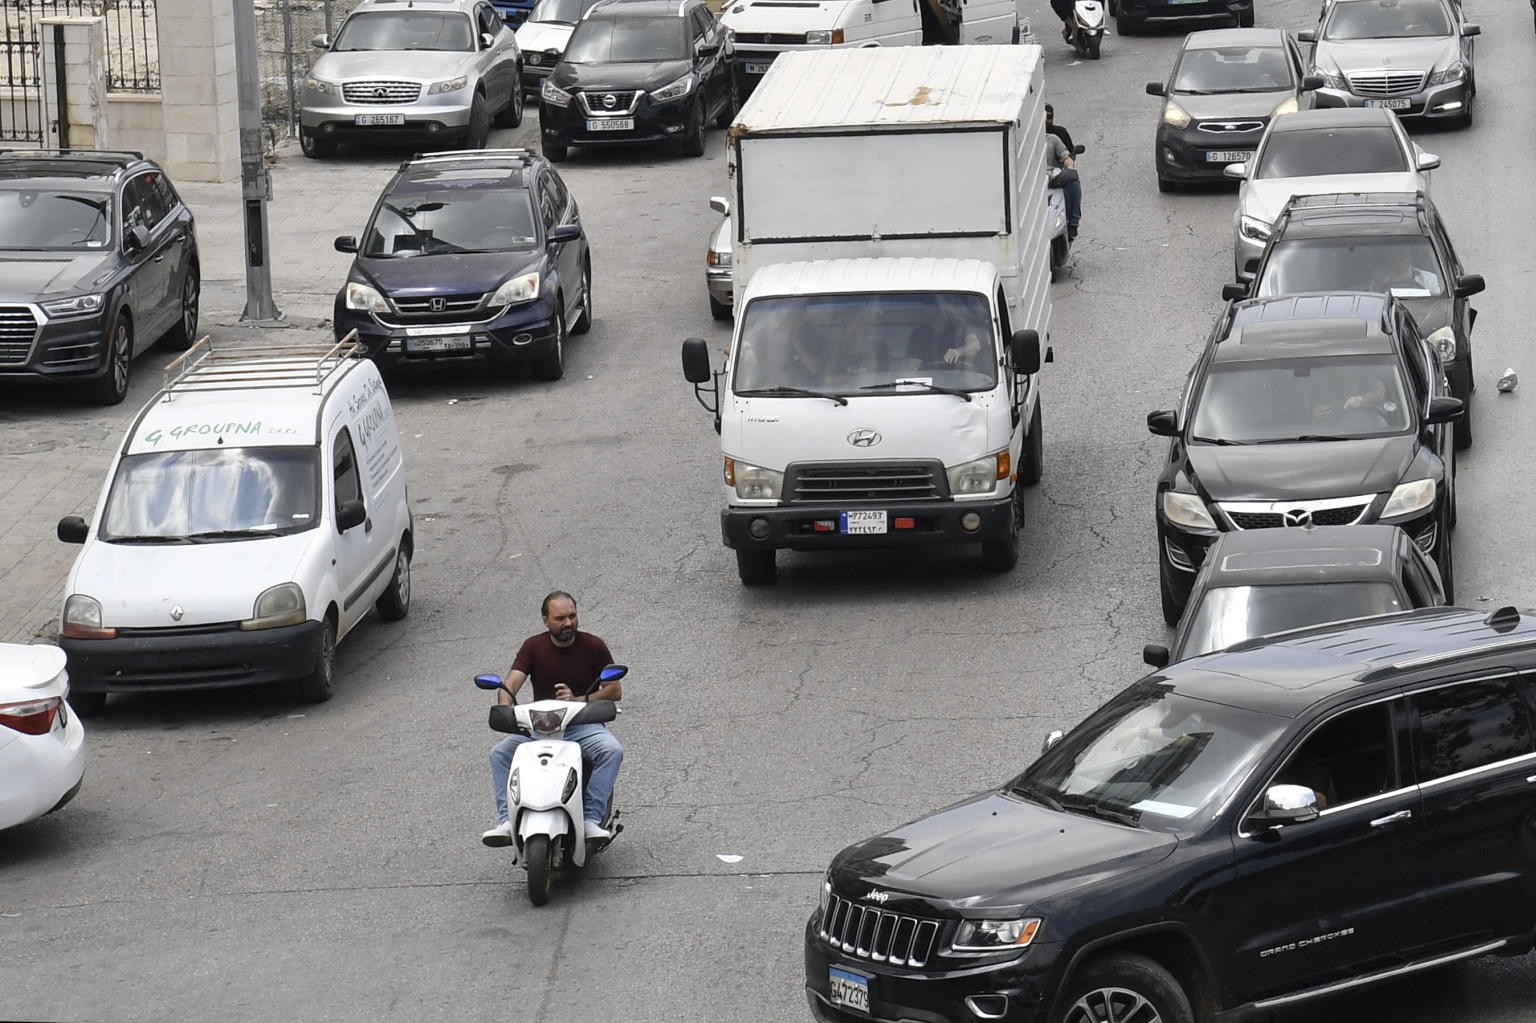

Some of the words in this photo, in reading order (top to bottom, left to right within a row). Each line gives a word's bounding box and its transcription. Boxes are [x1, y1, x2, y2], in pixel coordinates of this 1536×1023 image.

[1212, 152, 1218, 161] G
[169, 421, 262, 440] GROUPNA
[866, 888, 889, 904] Jeep
[1260, 942, 1296, 957] GRAND
[1298, 927, 1355, 947] CHEROKEE
[830, 980, 869, 1009] G472379
